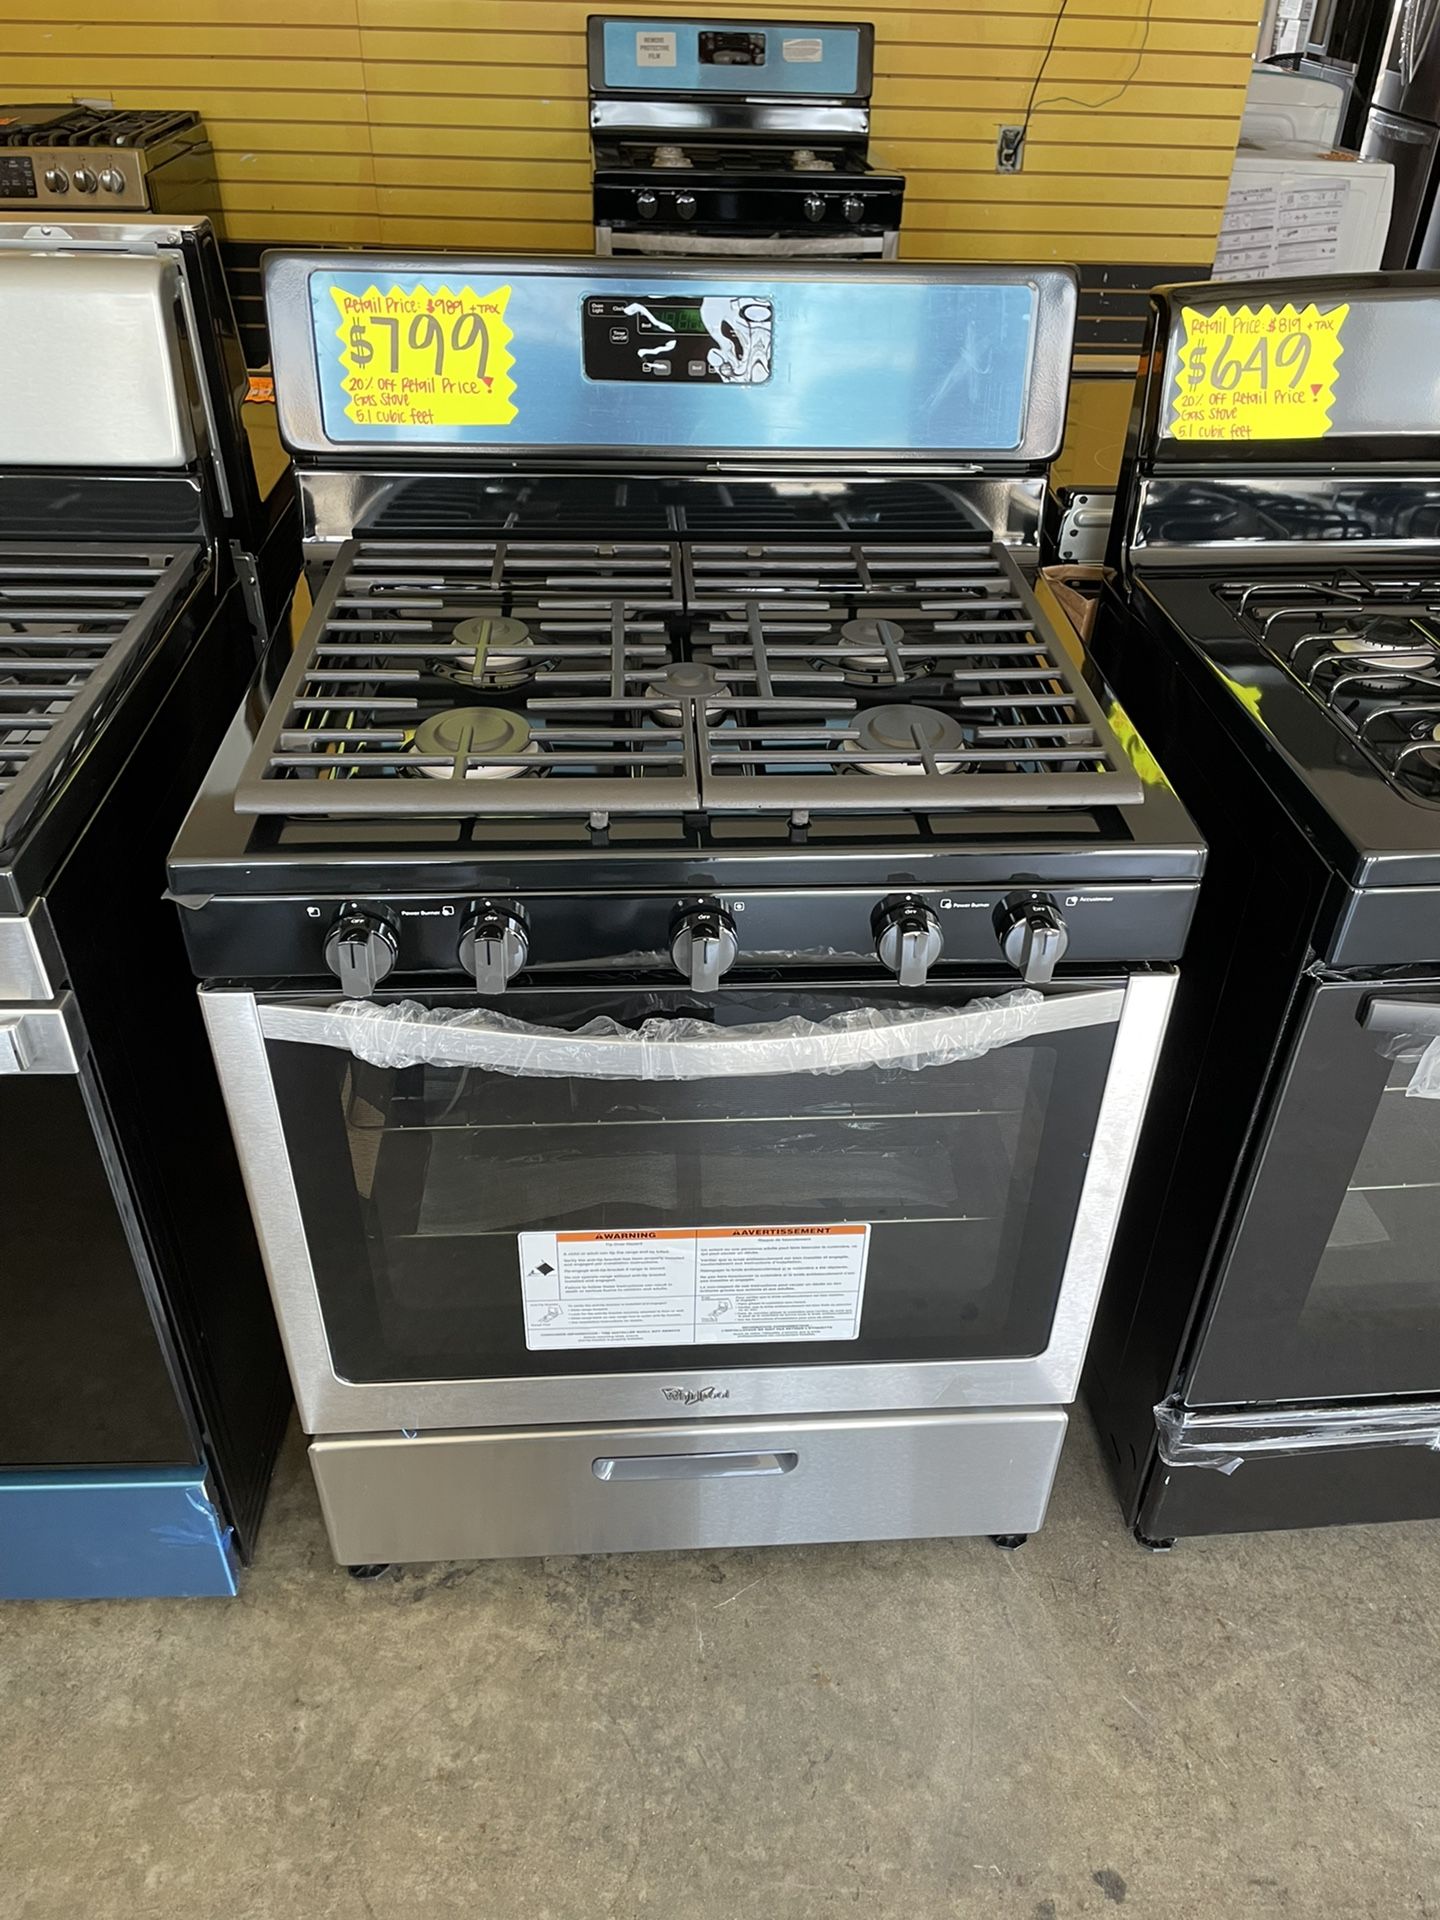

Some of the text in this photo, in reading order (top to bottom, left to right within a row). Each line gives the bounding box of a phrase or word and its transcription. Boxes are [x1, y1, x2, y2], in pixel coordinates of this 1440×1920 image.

[344, 297, 382, 314] Retail
[1191, 318, 1227, 335] Retail
[350, 313, 490, 379] $799
[1187, 332, 1312, 392] $649
[349, 377, 373, 392] 20%
[401, 377, 436, 394] Retail
[380, 392, 410, 407] Stove
[1181, 393, 1204, 407] 20%
[1233, 391, 1267, 405] Retail
[356, 408, 434, 425] 5.1 cubic feet
[1209, 407, 1237, 420] Stove
[741, 1228, 831, 1236] AVERTISSEMENT
